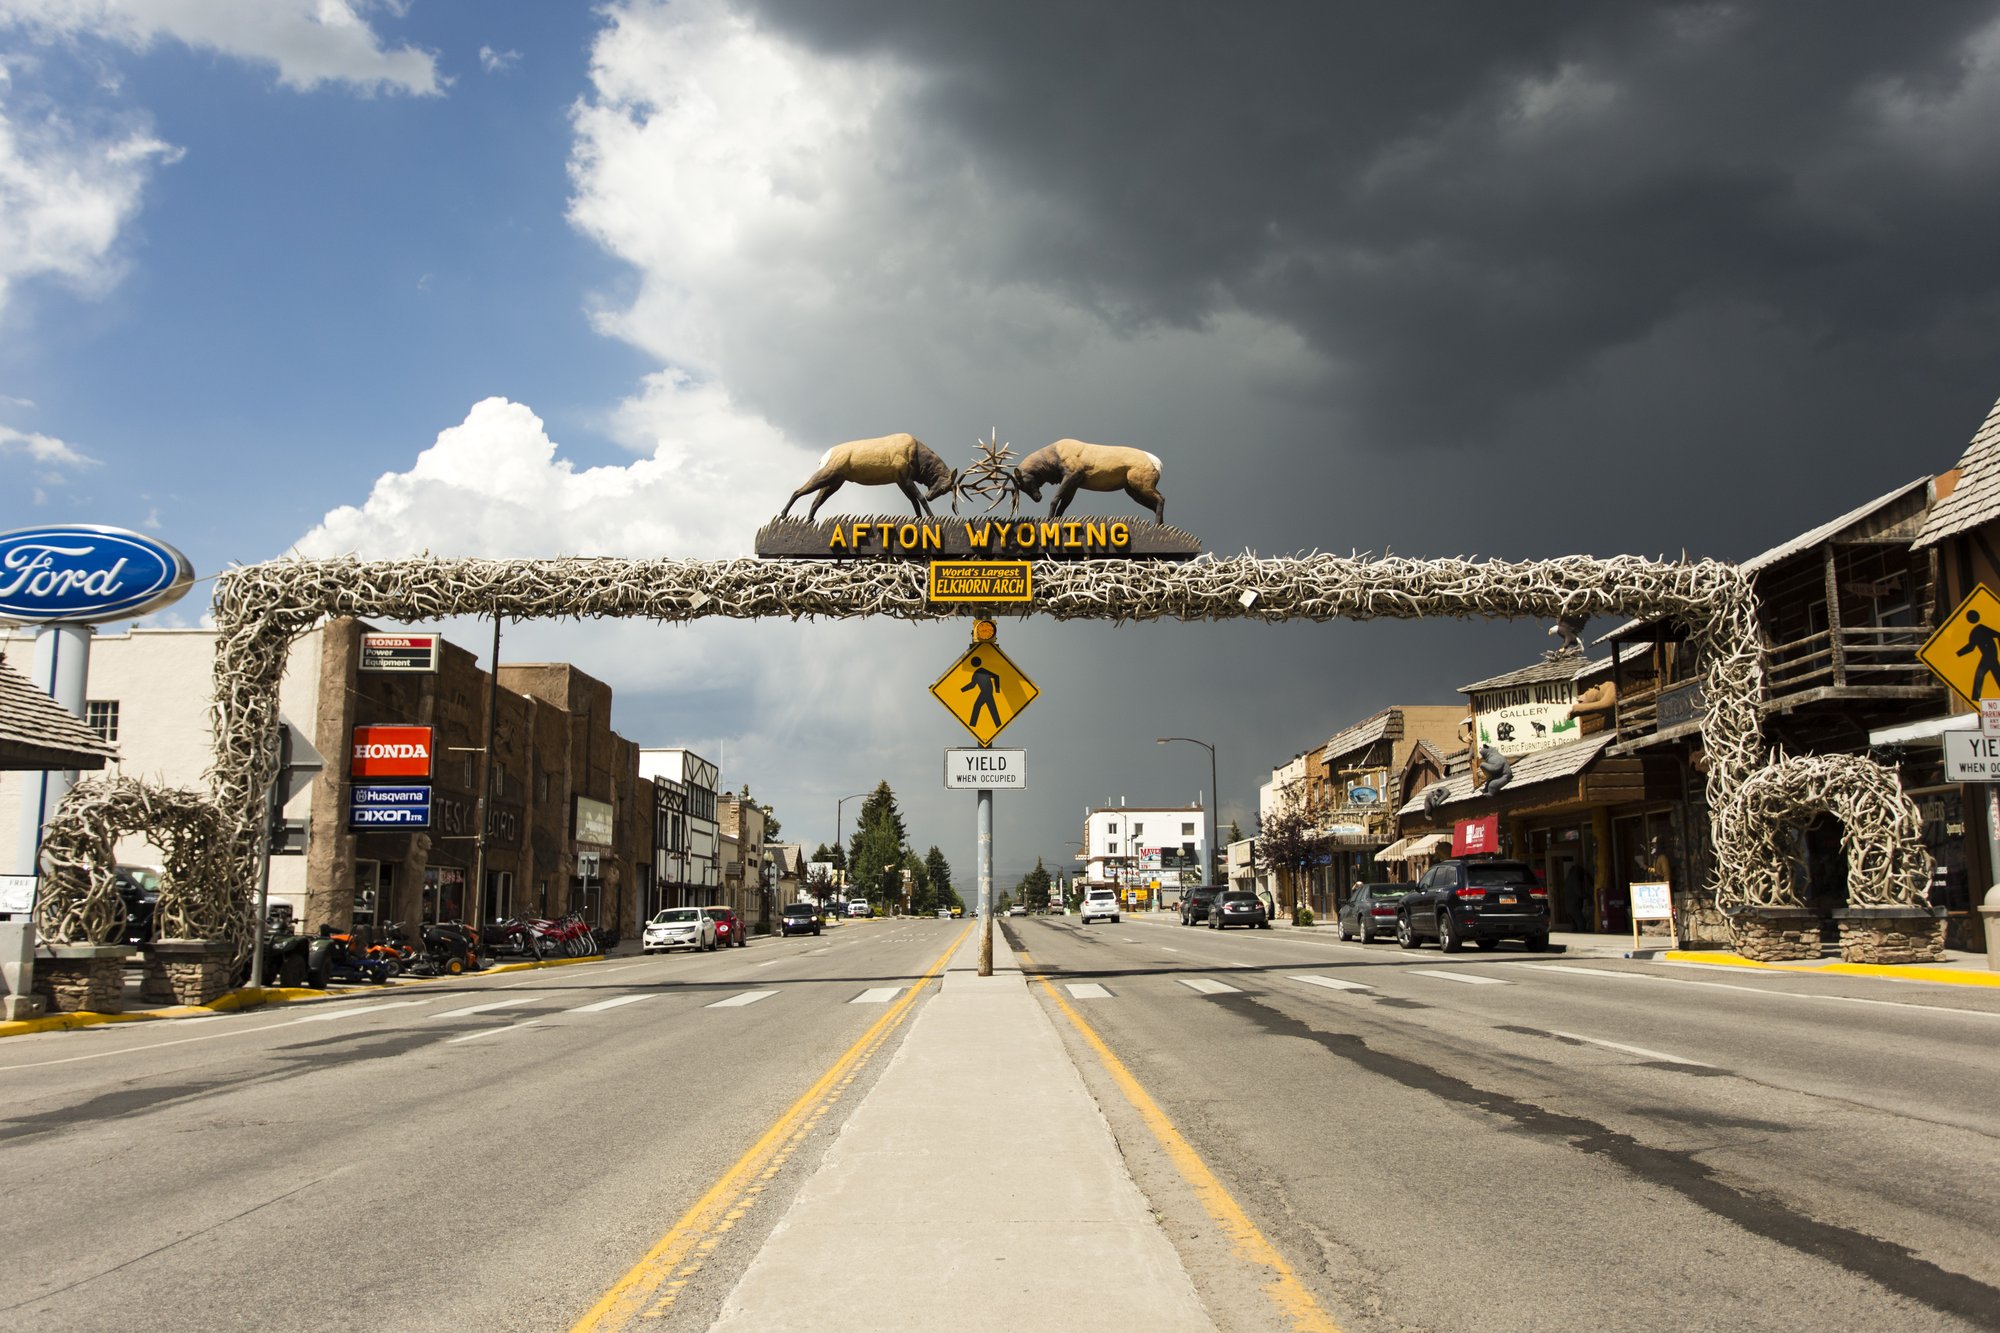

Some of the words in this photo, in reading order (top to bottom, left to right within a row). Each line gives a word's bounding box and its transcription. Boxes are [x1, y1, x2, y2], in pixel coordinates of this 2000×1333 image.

[829, 523, 942, 549] AFTON
[965, 522, 1129, 547] WYOMING
[0, 544, 129, 598] Ford
[942, 568, 979, 576] World's
[981, 568, 1020, 578] Largest
[936, 579, 990, 594] ELKHORN
[992, 579, 1025, 594] ARCH
[366, 639, 411, 647] HONDA
[365, 648, 394, 656] Power
[365, 658, 411, 667] Equipment
[1475, 689, 1530, 716] MOUNTAIN
[1534, 681, 1574, 705] VALLEY
[1988, 702, 1998, 710] NO
[1500, 707, 1549, 719] GALLERY
[354, 744, 428, 758] HONDA
[1969, 739, 2000, 757] YIE
[966, 757, 1007, 771] YIELD
[1959, 763, 1986, 773] WHEN
[367, 791, 423, 802] Husqvarna
